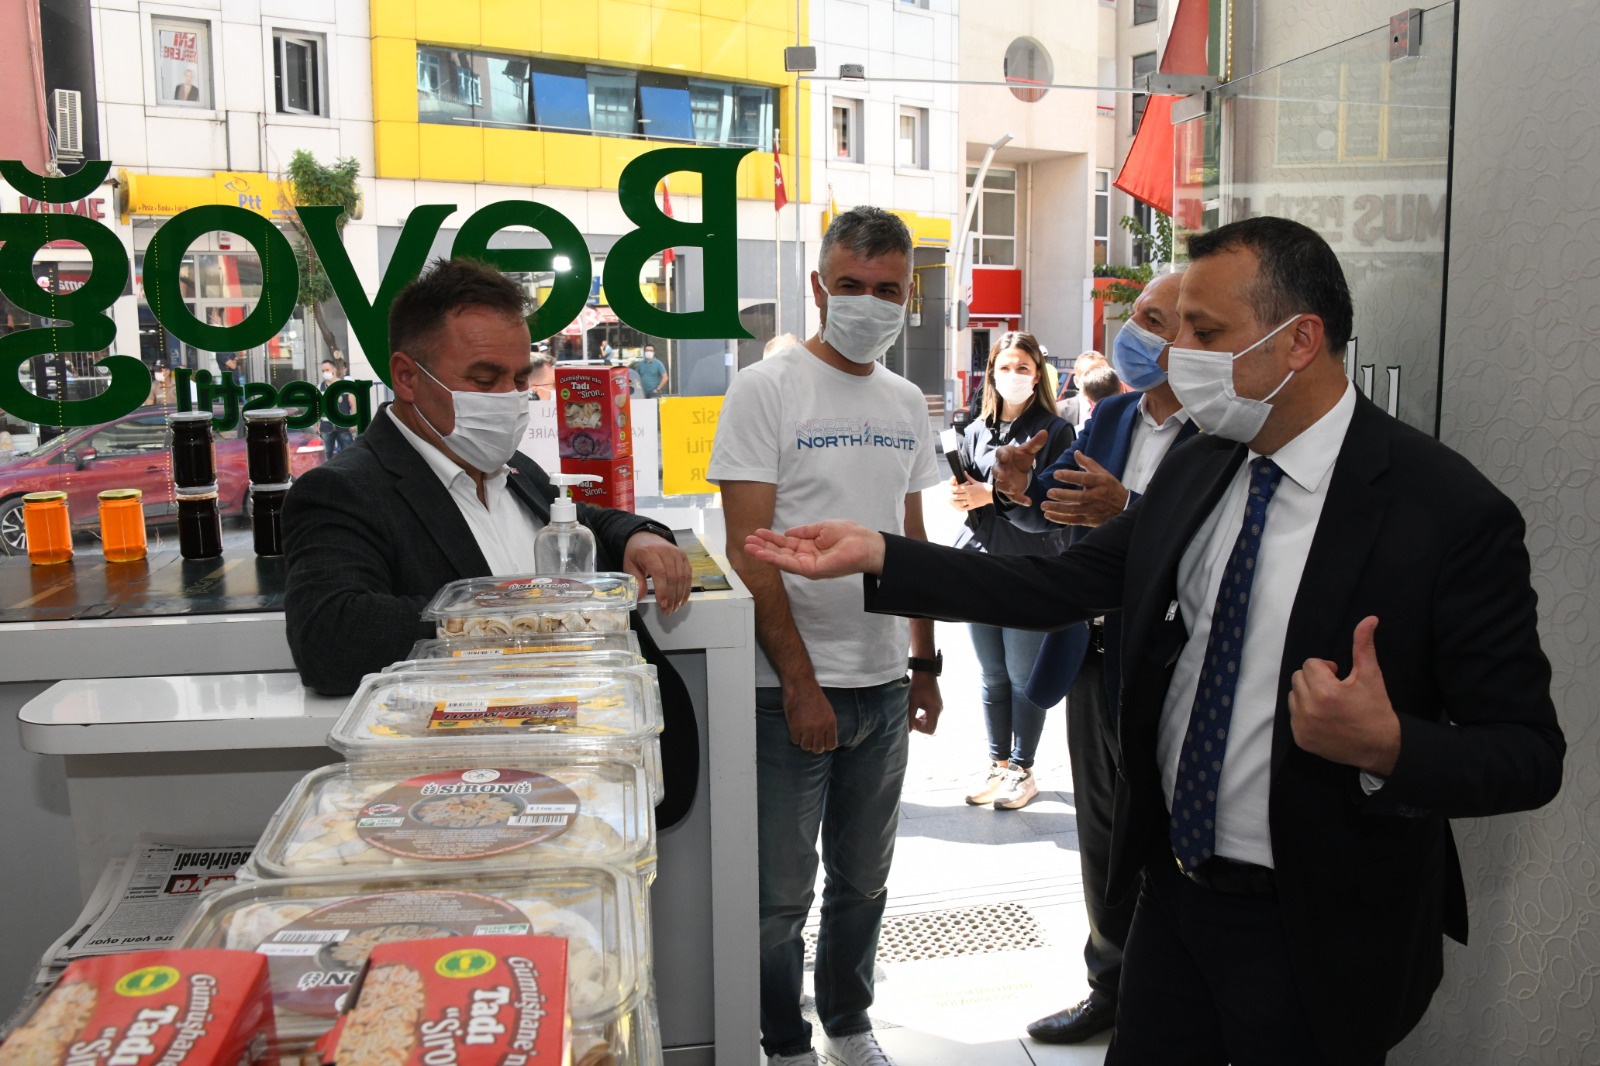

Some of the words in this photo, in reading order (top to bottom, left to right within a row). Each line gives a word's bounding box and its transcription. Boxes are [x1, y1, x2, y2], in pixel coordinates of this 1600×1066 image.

[238, 193, 262, 210] Ptt
[571, 381, 590, 390] Tadı
[797, 435, 862, 450] NORTH
[873, 435, 916, 450] ROUTE
[438, 782, 515, 795] SİRON
[88, 937, 119, 945] ayar
[121, 936, 151, 944] yeni
[465, 985, 511, 1045] Tadı
[107, 1004, 180, 1066] Tadı
